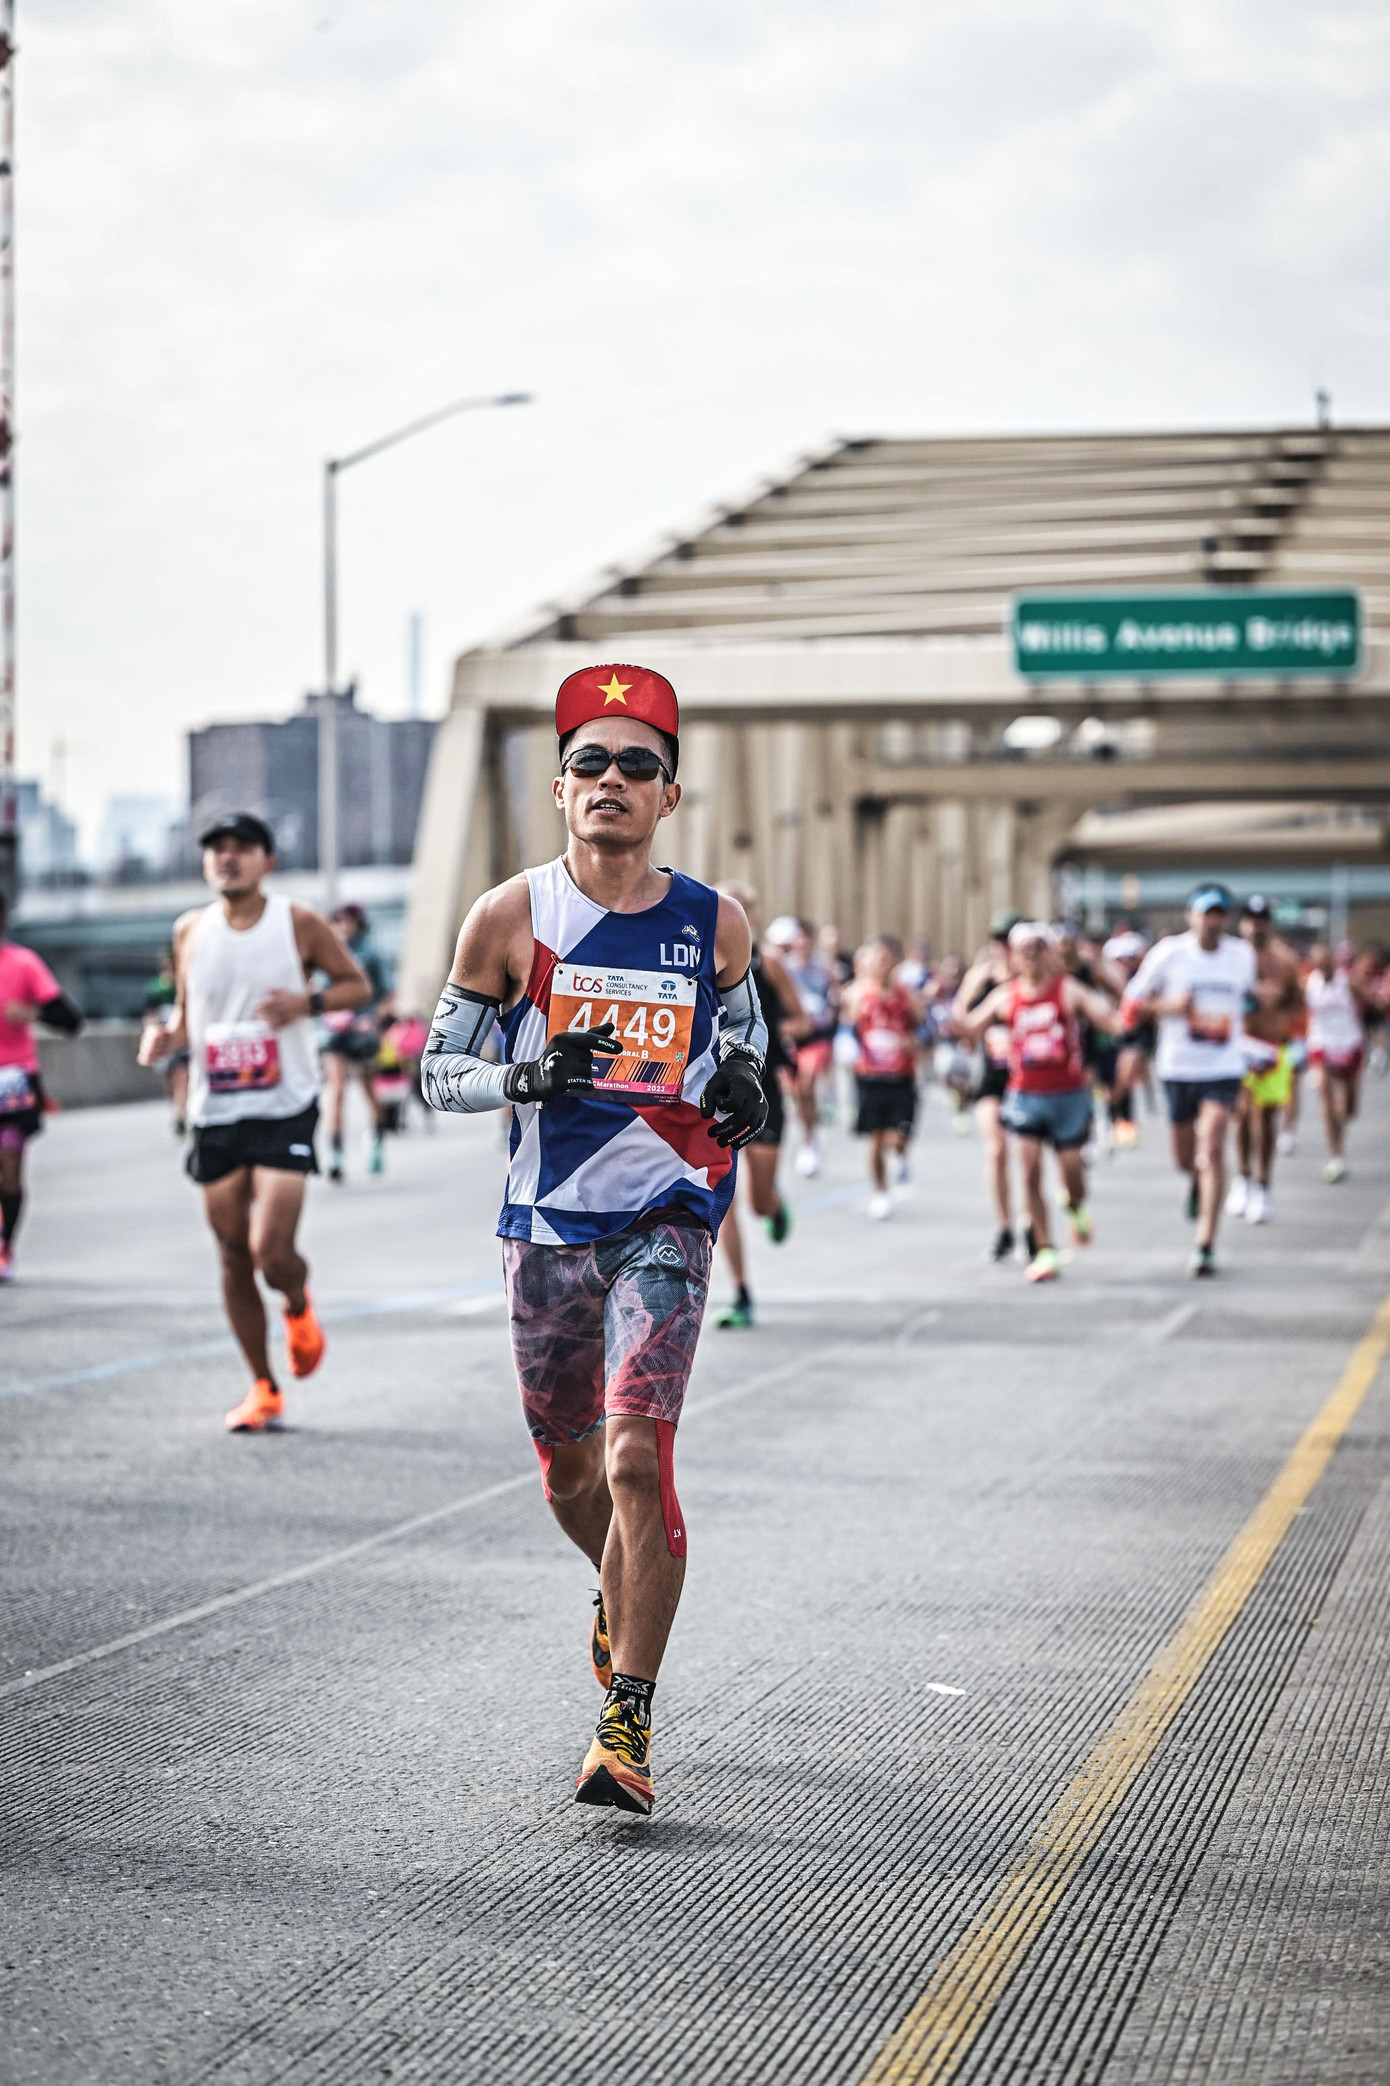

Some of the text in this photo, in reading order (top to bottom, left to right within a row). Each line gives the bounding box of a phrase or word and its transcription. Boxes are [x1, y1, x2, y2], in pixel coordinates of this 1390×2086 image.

[1020, 615, 1353, 658] Willis Avenue Bridge
[573, 971, 603, 993] tcs
[606, 982, 648, 991] CONSULTANCY
[605, 988, 632, 996] SERVICES
[658, 992, 678, 1000] TATA
[567, 1002, 676, 1048] 4449
[597, 1039, 615, 1050] BRONX
[641, 1050, 649, 1059] B
[673, 1528, 682, 1538] KT
